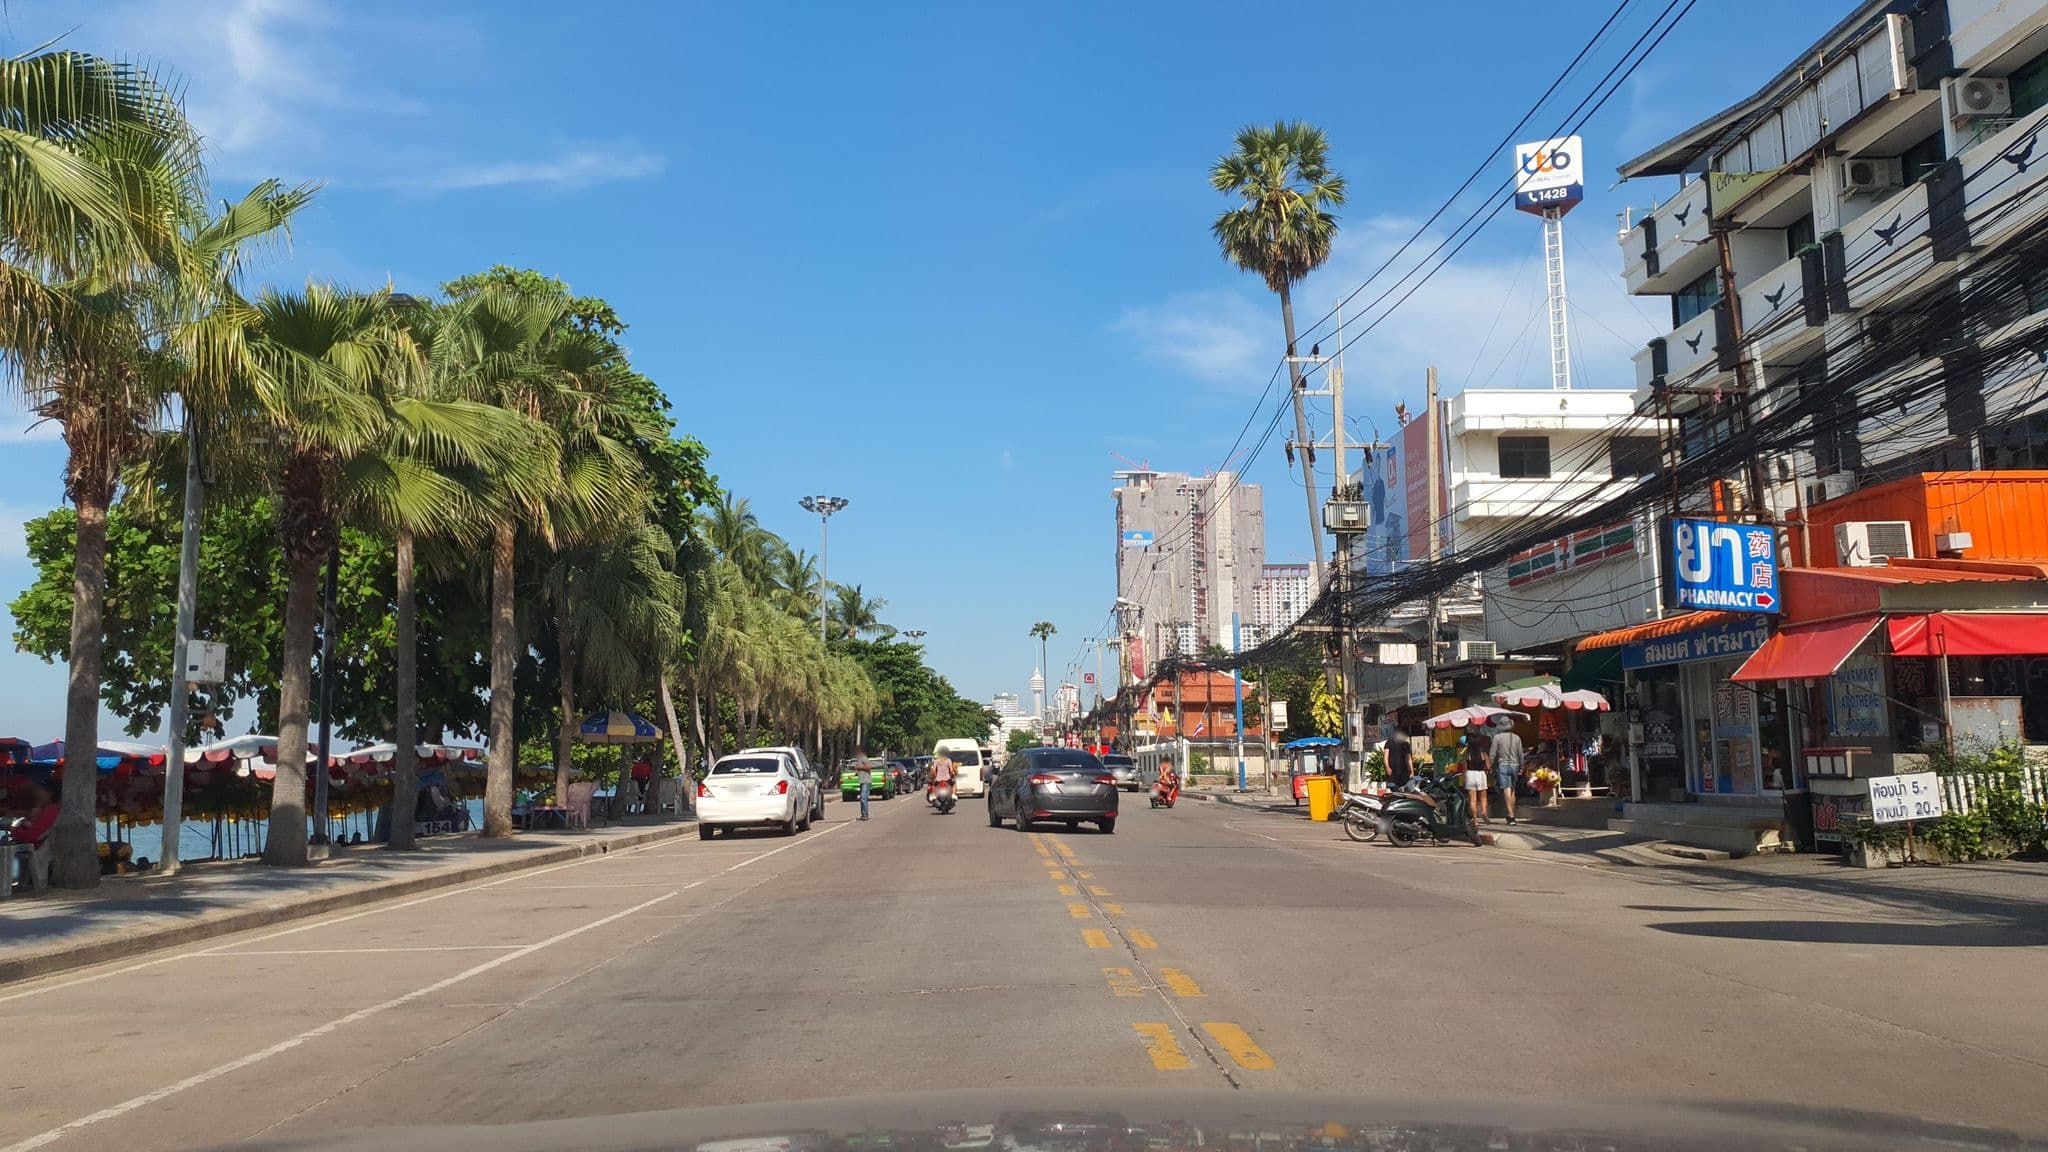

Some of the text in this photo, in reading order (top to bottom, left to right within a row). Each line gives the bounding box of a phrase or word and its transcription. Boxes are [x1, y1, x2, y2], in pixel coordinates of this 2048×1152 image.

[1522, 149, 1571, 175] ttb
[1538, 187, 1568, 201] 1428
[1677, 523, 1744, 586] ยา
[1746, 531, 1773, 589] 药店
[1680, 588, 1753, 607] PHARMACY
[1645, 642, 1689, 663] สมยศ
